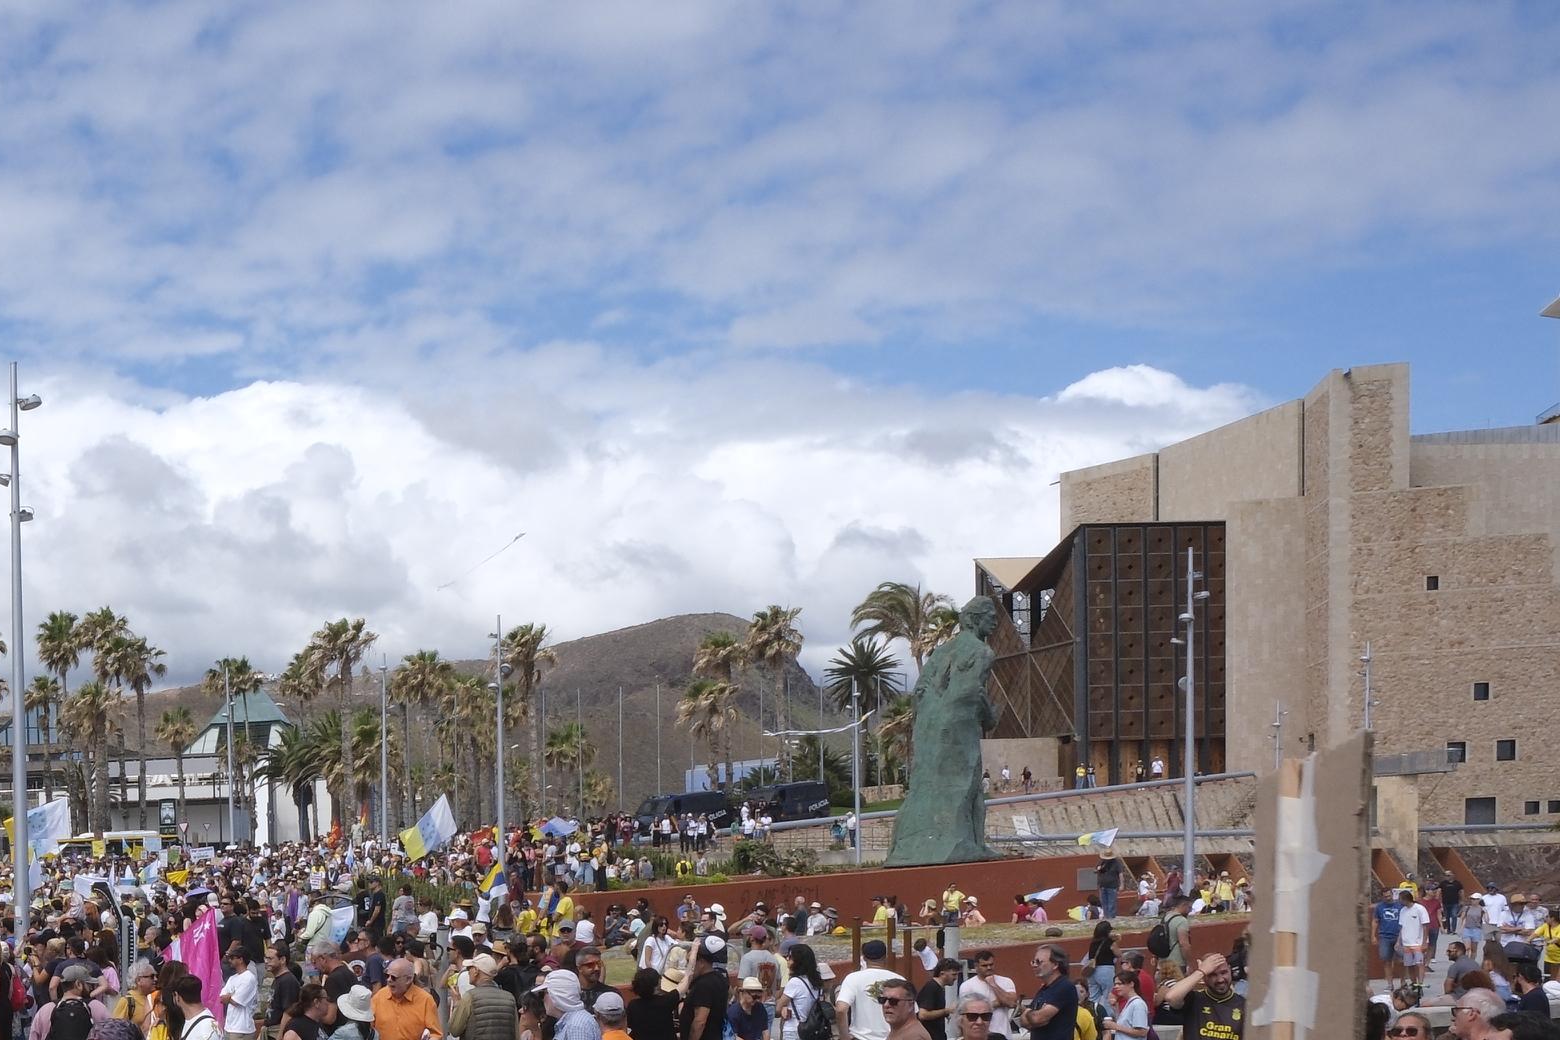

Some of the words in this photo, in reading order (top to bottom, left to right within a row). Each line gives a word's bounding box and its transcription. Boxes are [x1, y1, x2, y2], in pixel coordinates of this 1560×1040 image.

[707, 809, 727, 821] OLICIA
[1206, 1021, 1232, 1032] Gran
[1200, 1028, 1240, 1040] Canaria
